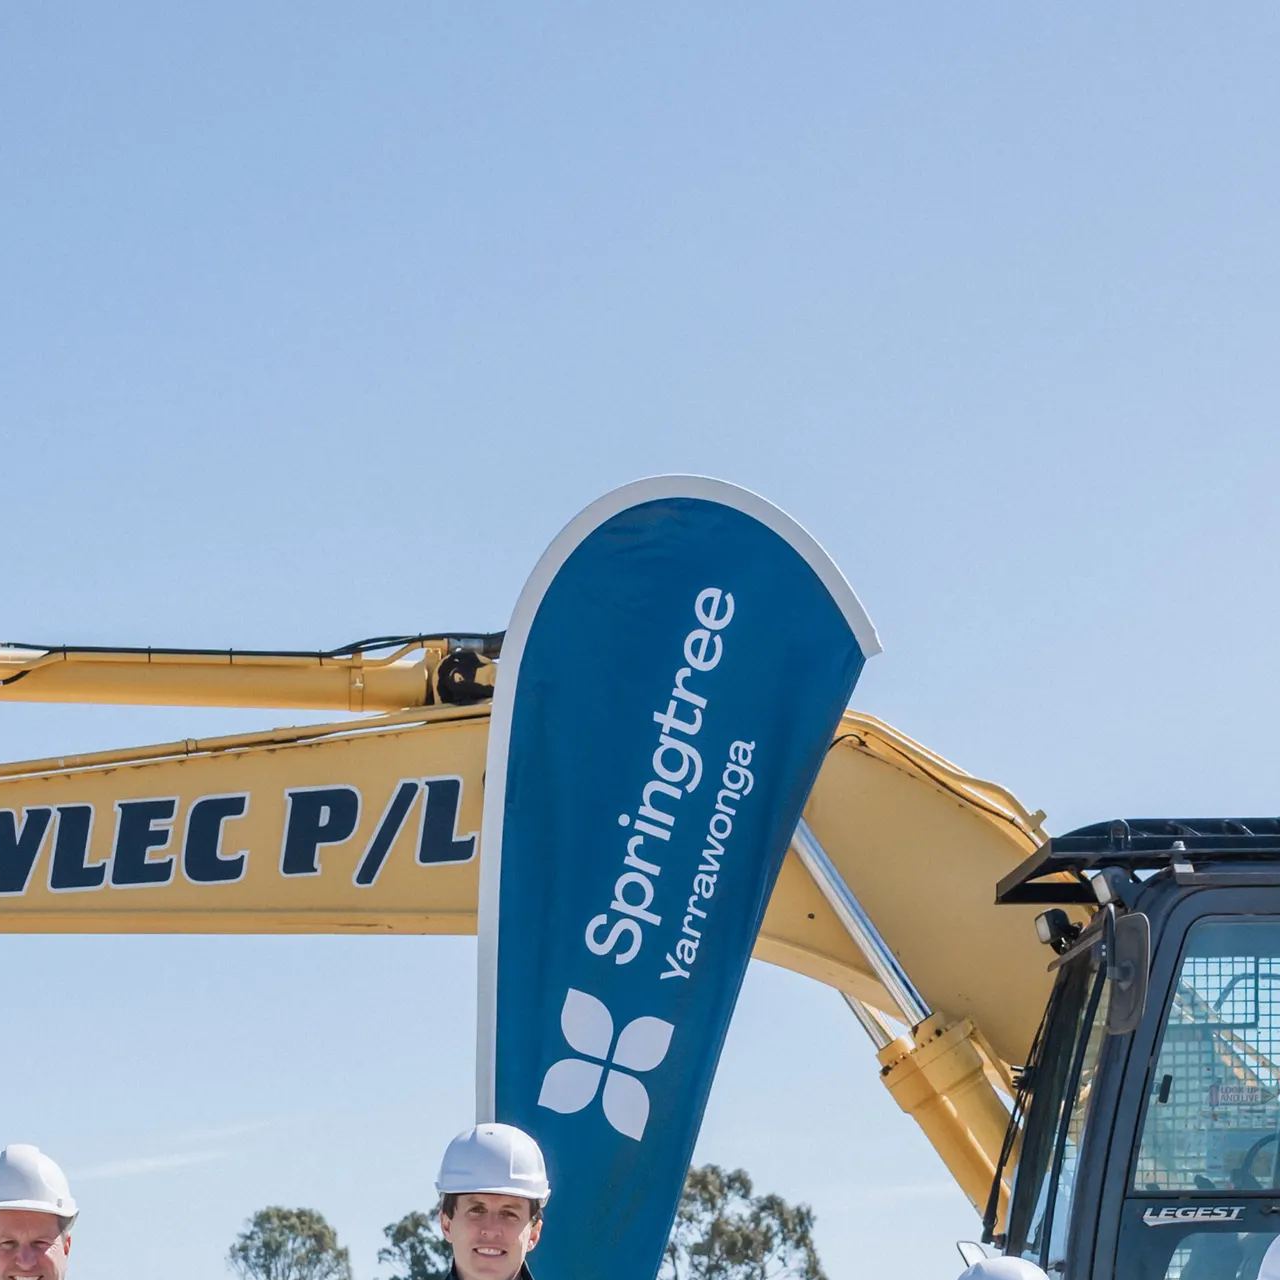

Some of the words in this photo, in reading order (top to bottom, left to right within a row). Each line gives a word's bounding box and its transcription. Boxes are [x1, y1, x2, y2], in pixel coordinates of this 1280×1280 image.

[278, 774, 478, 888] P/L
[585, 587, 735, 966] Springtree
[660, 740, 756, 980] Yarrawonga
[1142, 1206, 1247, 1220] LEGEST
